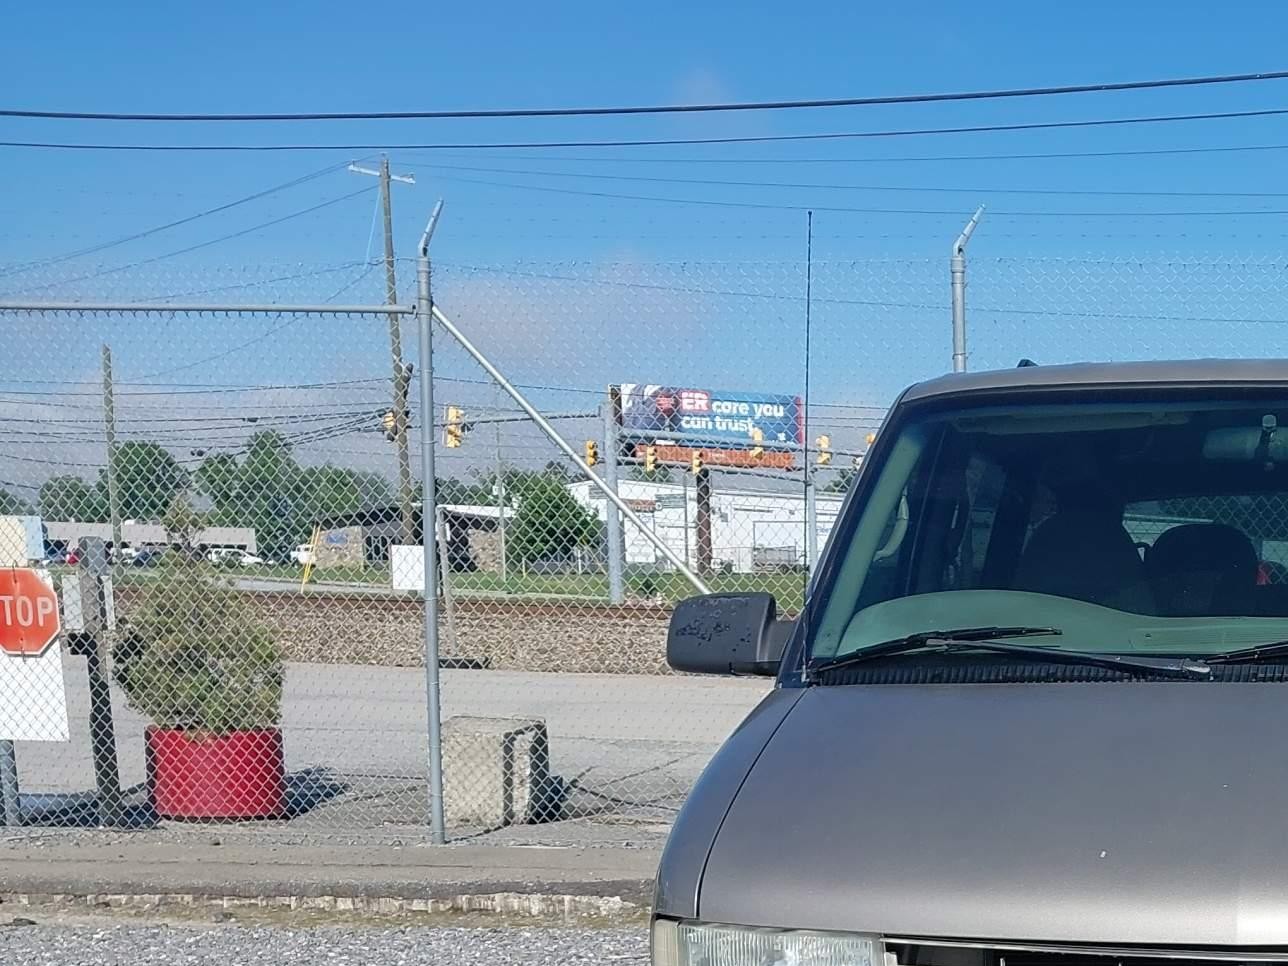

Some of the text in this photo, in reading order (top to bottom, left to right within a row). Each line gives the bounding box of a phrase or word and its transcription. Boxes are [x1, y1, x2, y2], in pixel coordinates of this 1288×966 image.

[681, 391, 785, 419] ER care you
[681, 415, 713, 430] can
[0, 595, 54, 627] TOP
